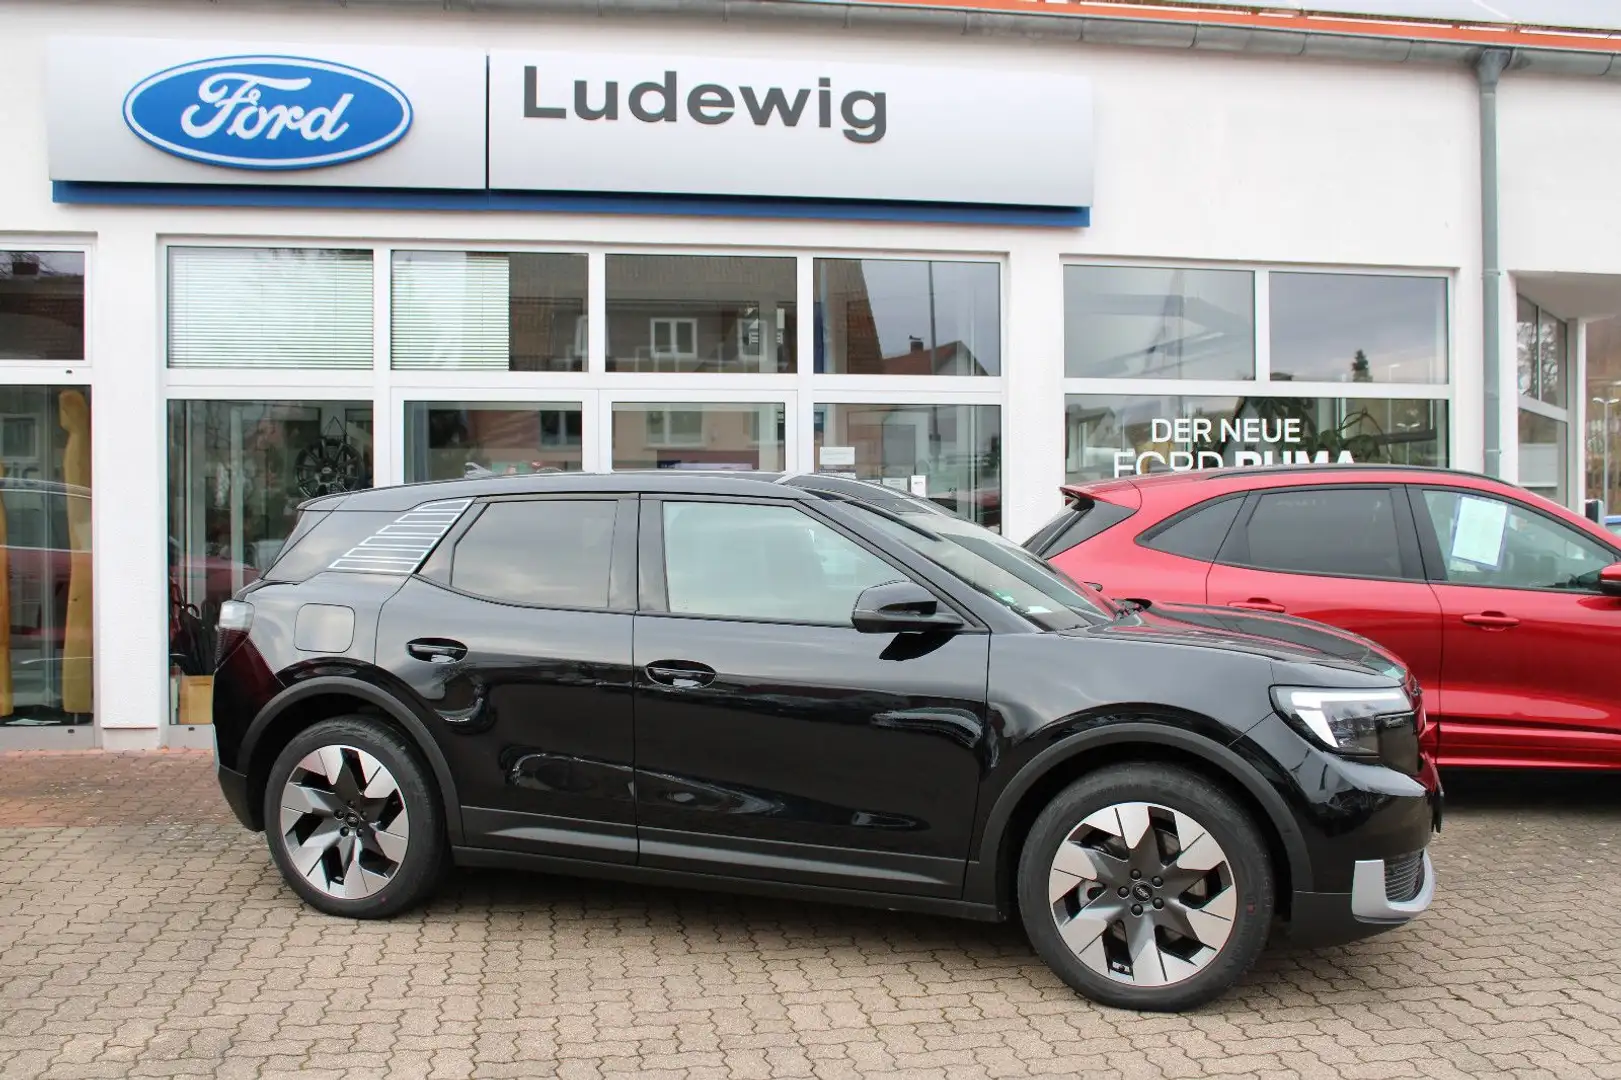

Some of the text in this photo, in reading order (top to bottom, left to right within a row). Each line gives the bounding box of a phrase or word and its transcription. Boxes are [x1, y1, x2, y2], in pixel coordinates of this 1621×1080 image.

[180, 72, 355, 142] Ford
[523, 65, 887, 144] Ludewig
[1151, 418, 1301, 443] DER NEUE
